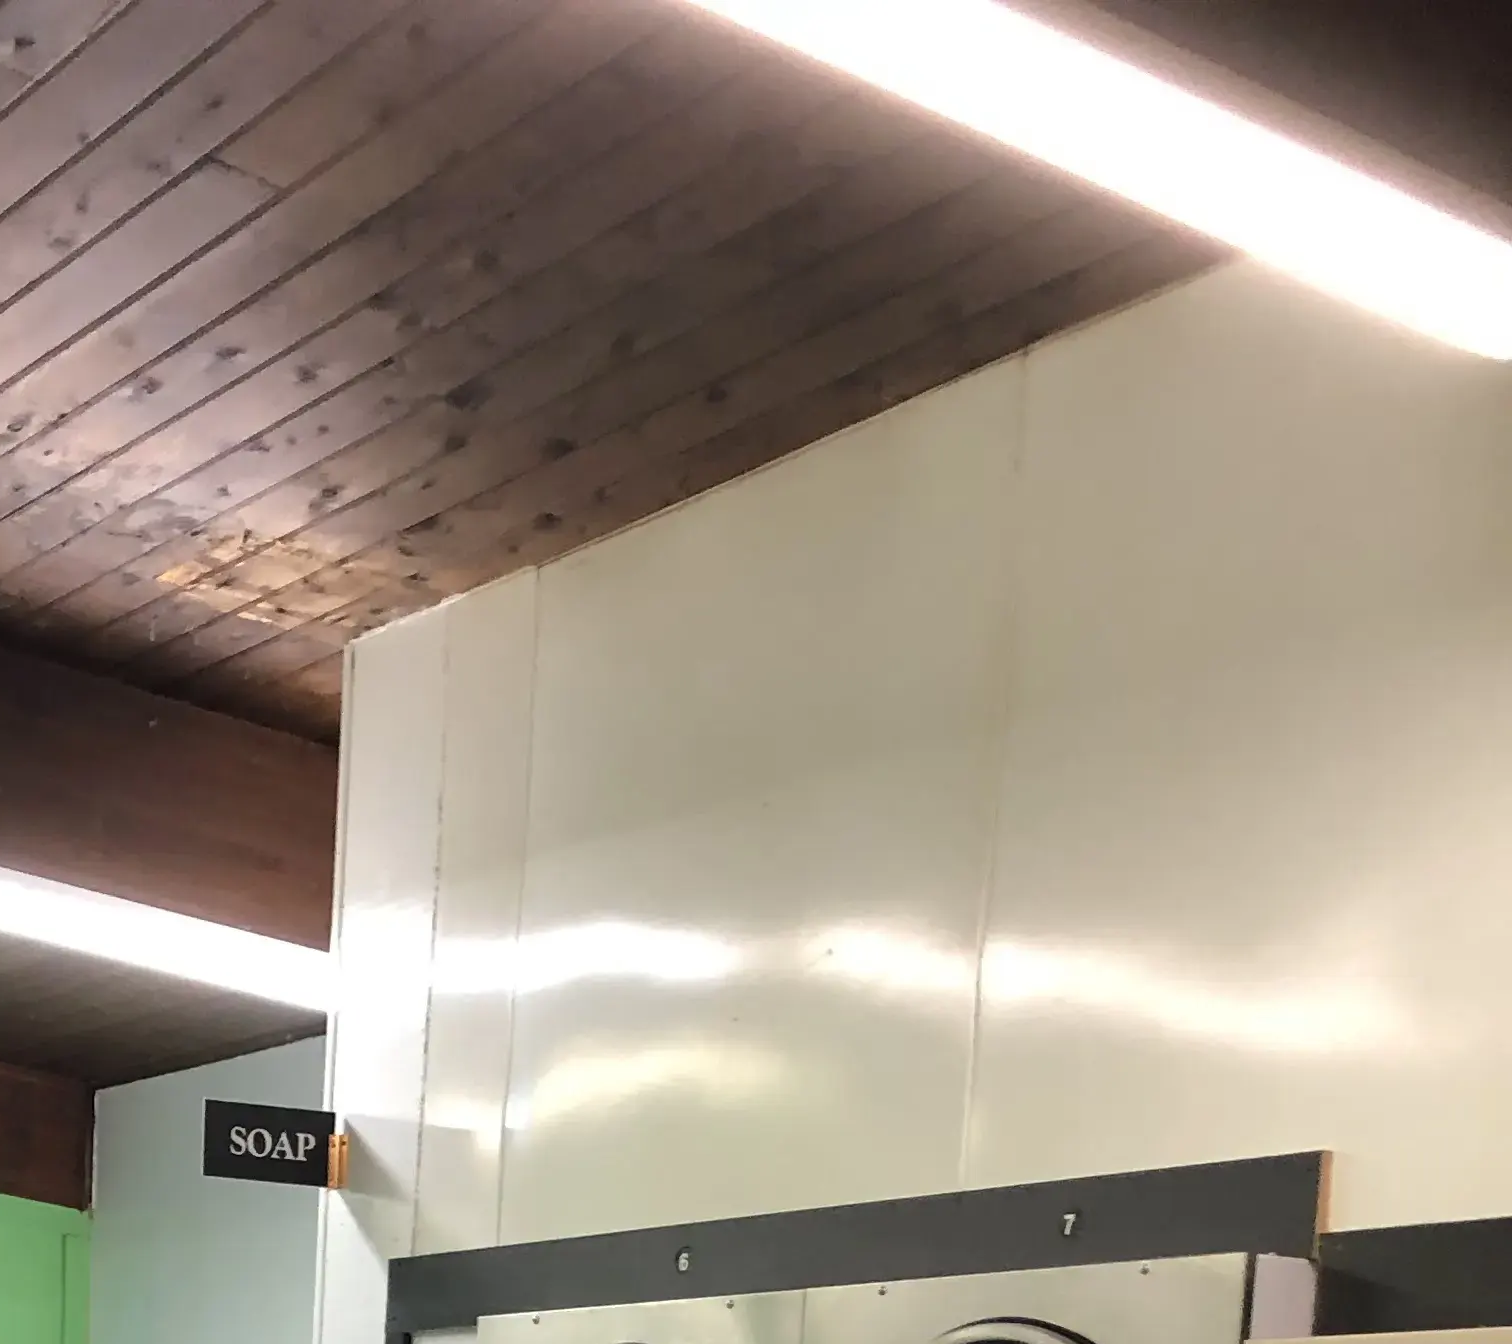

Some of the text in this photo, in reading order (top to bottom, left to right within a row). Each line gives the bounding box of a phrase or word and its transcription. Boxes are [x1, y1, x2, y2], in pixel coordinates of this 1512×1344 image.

[229, 1125, 317, 1162] SOAP
[1063, 1213, 1077, 1236] 7
[678, 1252, 689, 1271] 6
